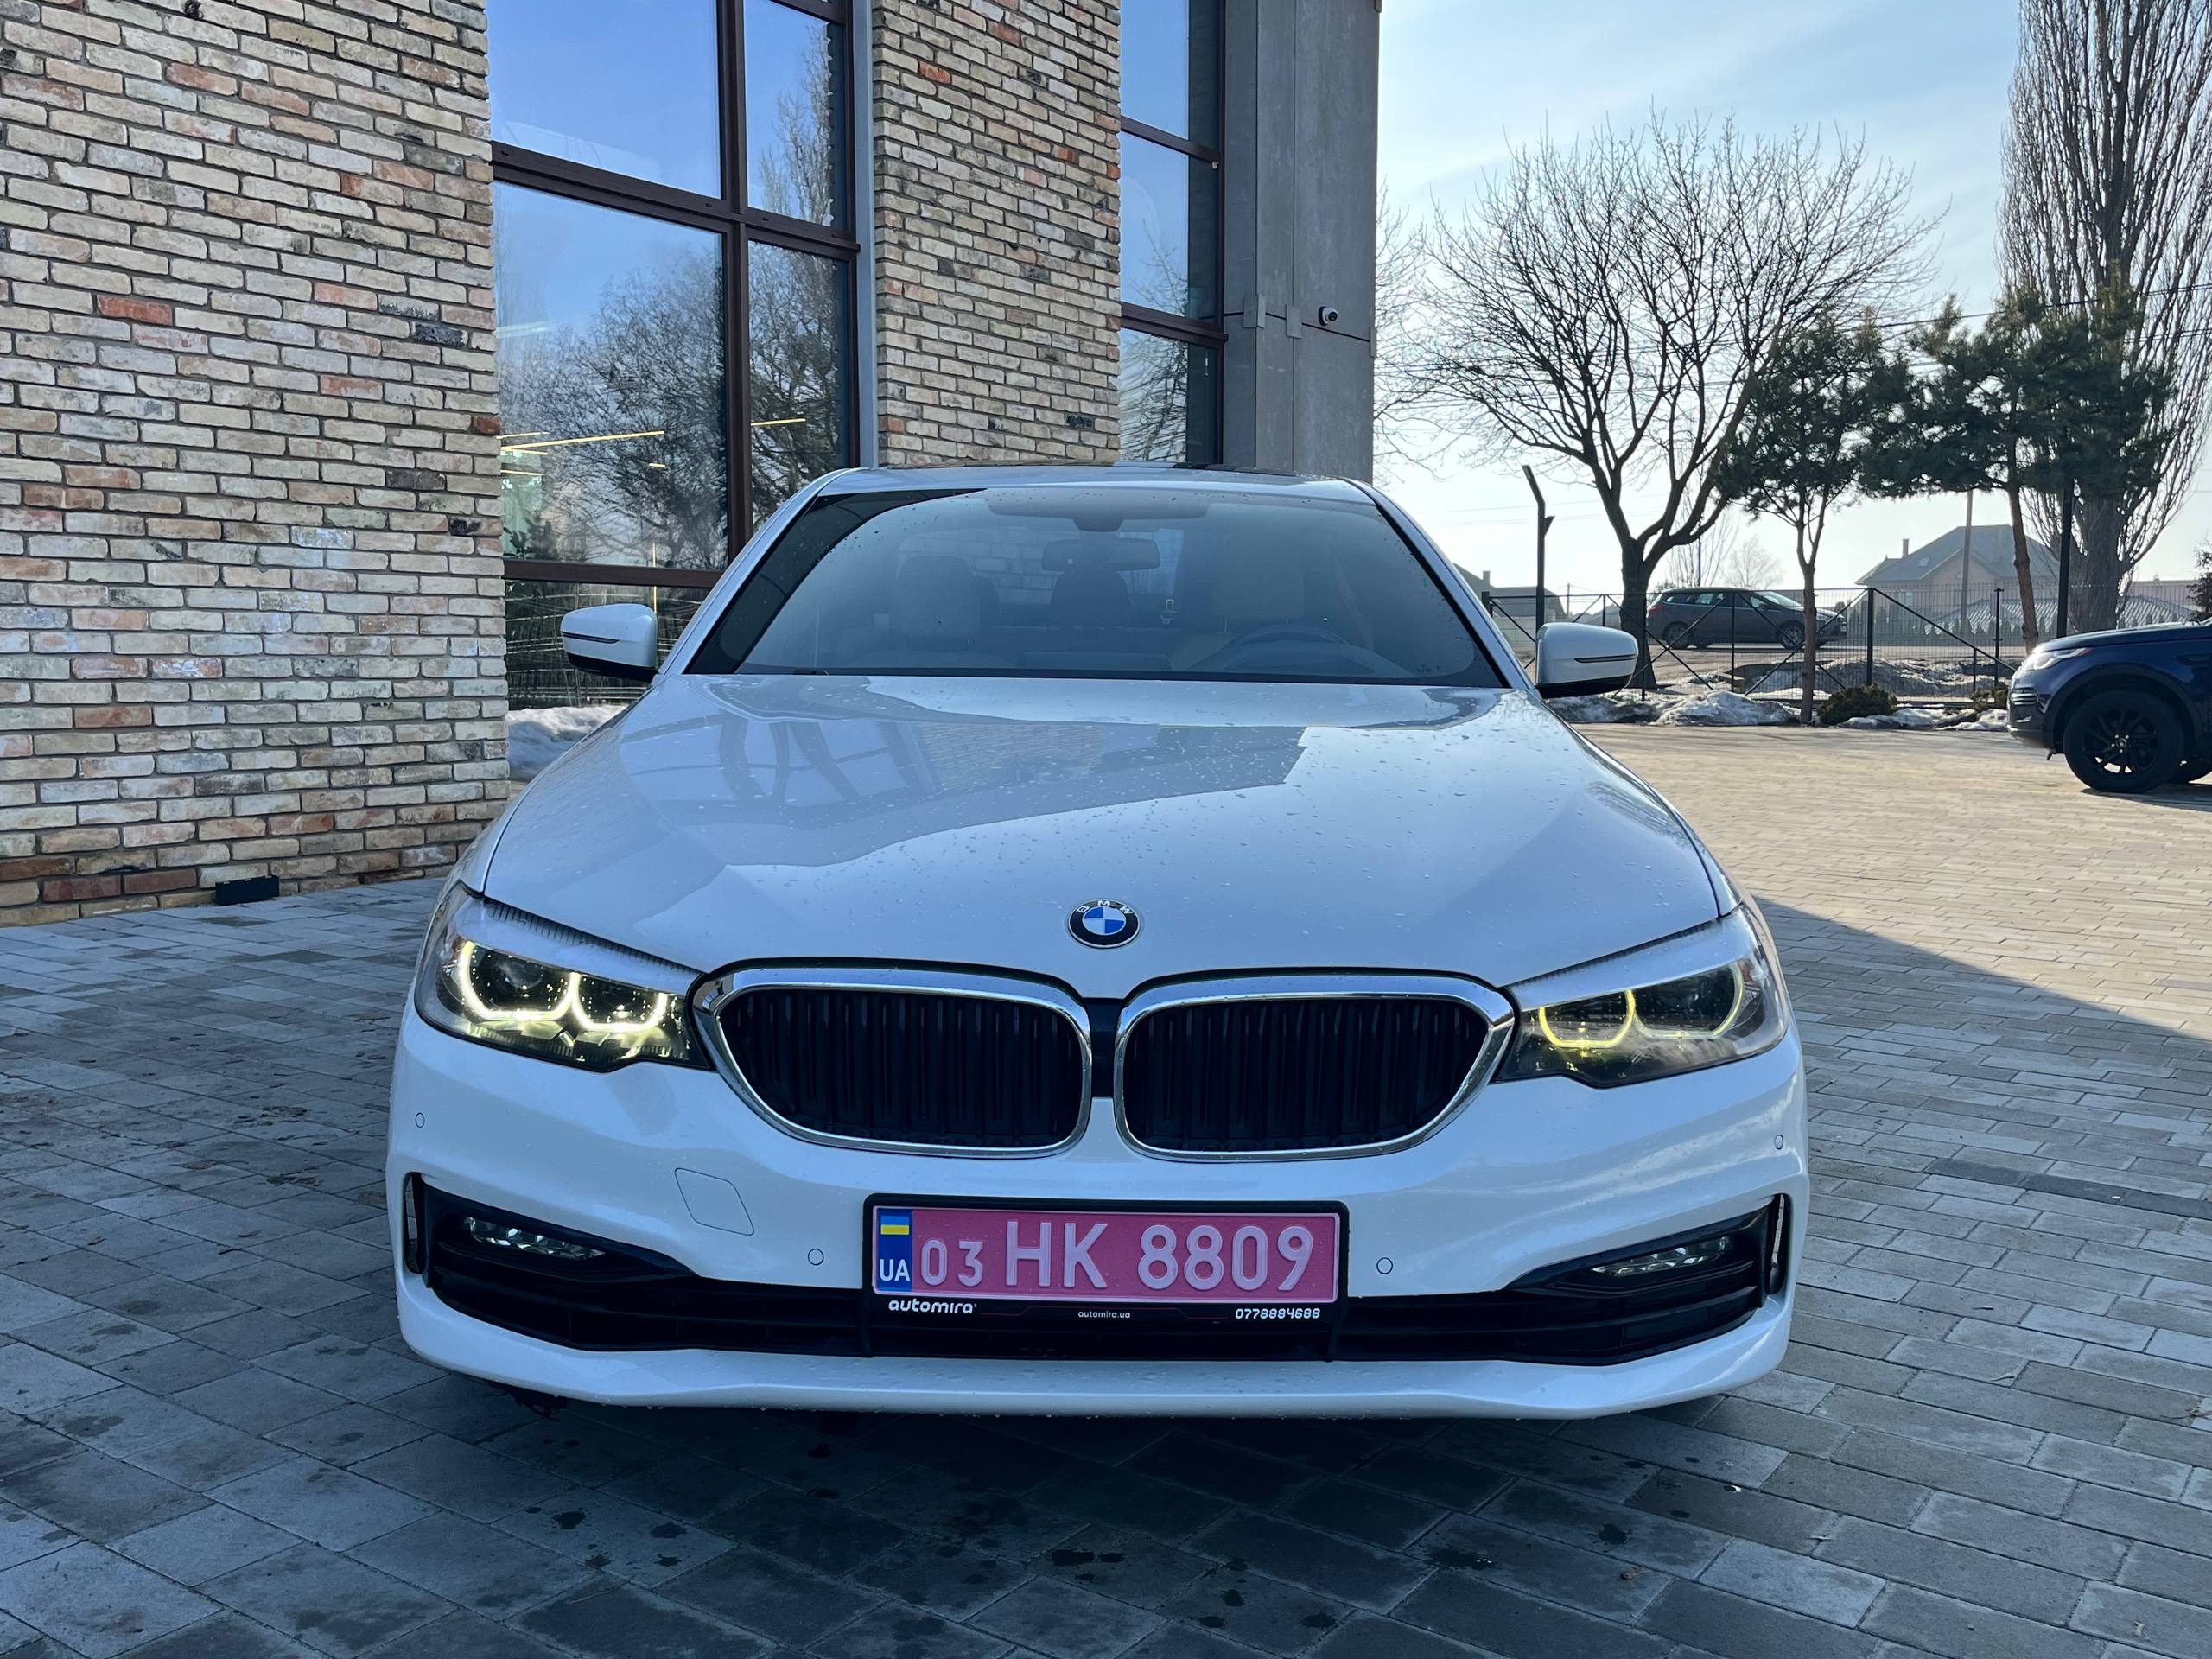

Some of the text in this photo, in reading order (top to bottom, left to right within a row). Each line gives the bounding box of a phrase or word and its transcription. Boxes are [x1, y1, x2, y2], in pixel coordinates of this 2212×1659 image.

[1077, 900, 1133, 914] BMW
[880, 1221, 1314, 1291] UA 03 HK 8809
[888, 1298, 973, 1314] automira
[1235, 1307, 1321, 1319] 0778884688
[1077, 1310, 1131, 1319] automira.ua
